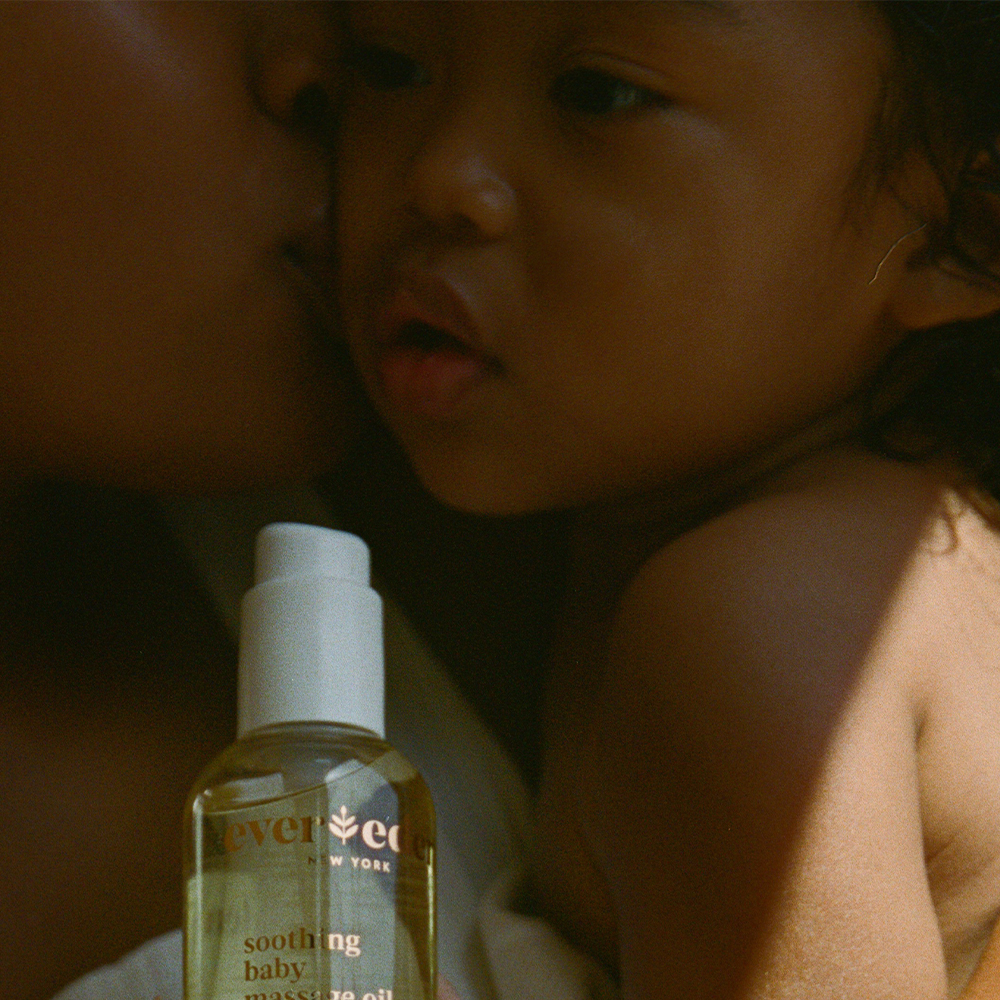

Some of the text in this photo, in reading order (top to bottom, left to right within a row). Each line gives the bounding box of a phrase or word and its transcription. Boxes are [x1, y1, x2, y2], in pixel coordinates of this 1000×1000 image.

[308, 855, 391, 873] NEW YORK
[244, 927, 361, 957] soothing
[244, 957, 307, 983] baby
